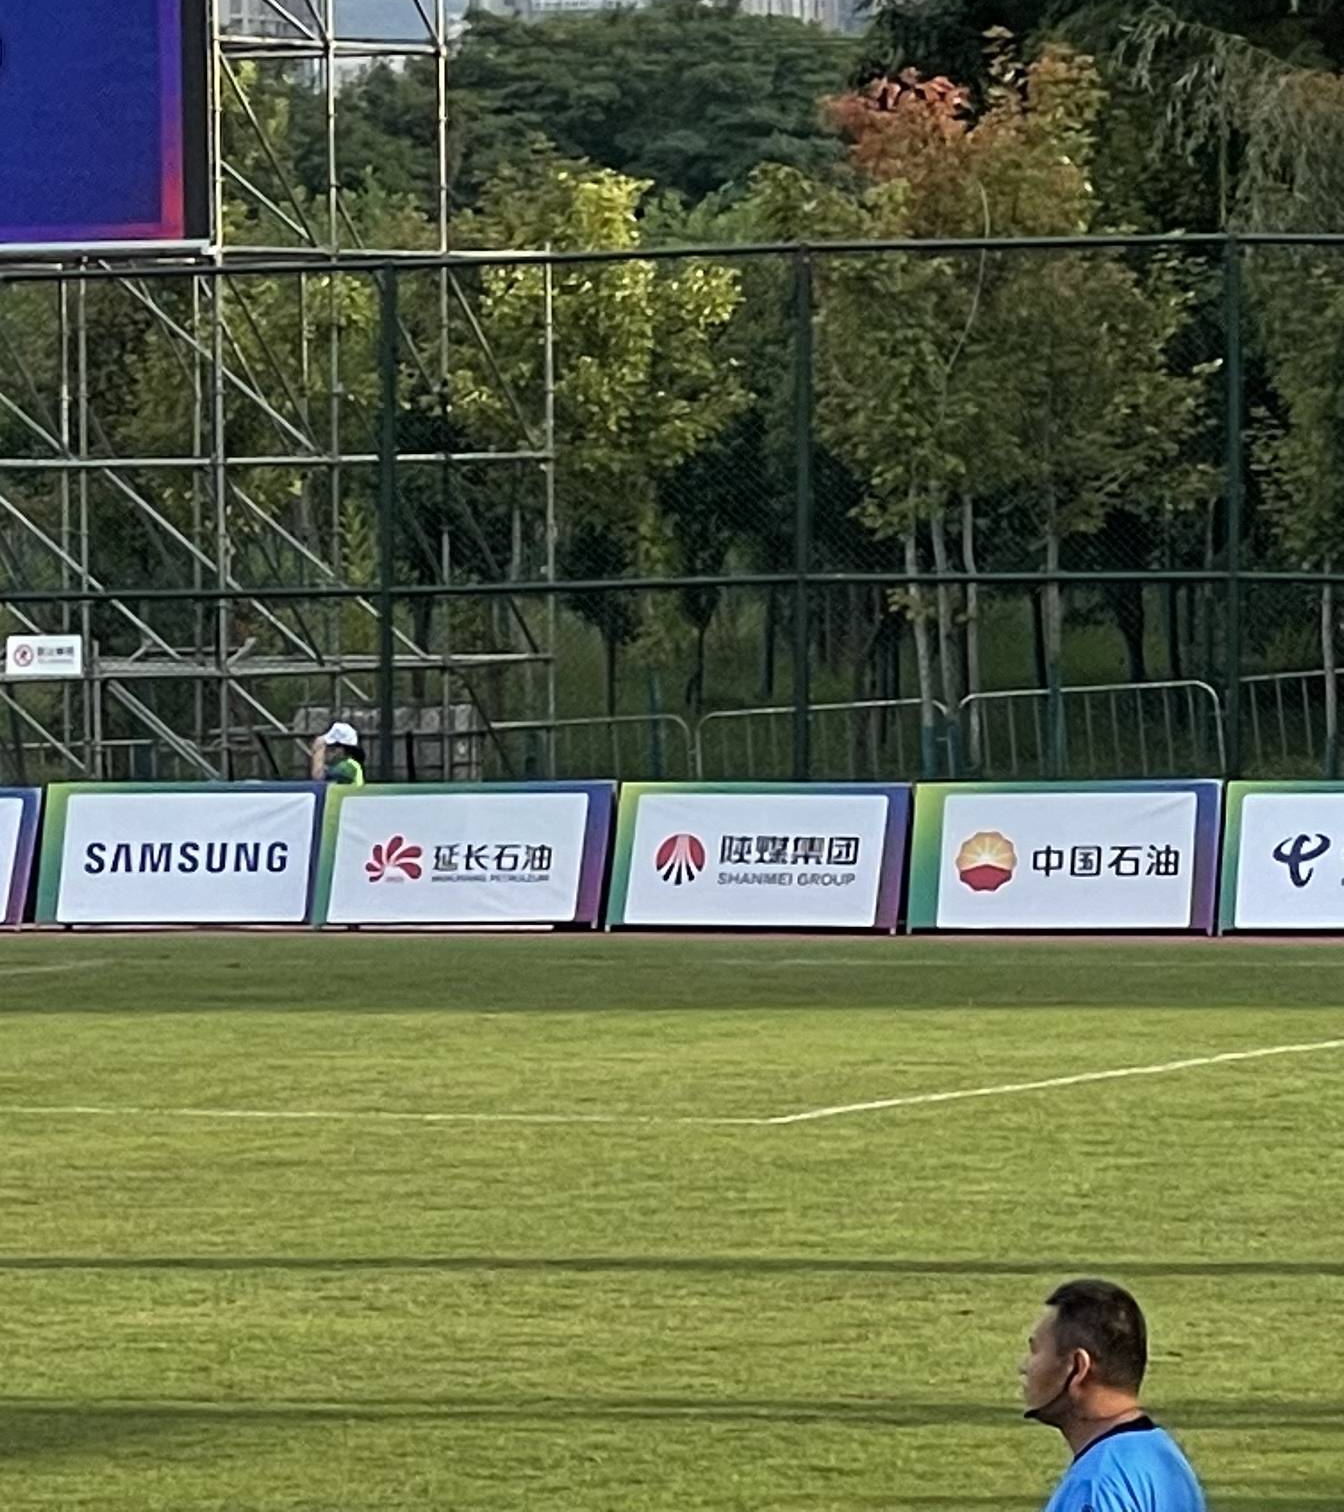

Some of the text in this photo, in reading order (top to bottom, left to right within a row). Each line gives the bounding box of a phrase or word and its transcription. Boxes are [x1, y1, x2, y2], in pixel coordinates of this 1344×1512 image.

[84, 841, 289, 874] SAMSUNG
[432, 844, 552, 871] 延长石油
[1032, 844, 1180, 877] 中国石油
[717, 872, 856, 886] SHANMEI GROUP
